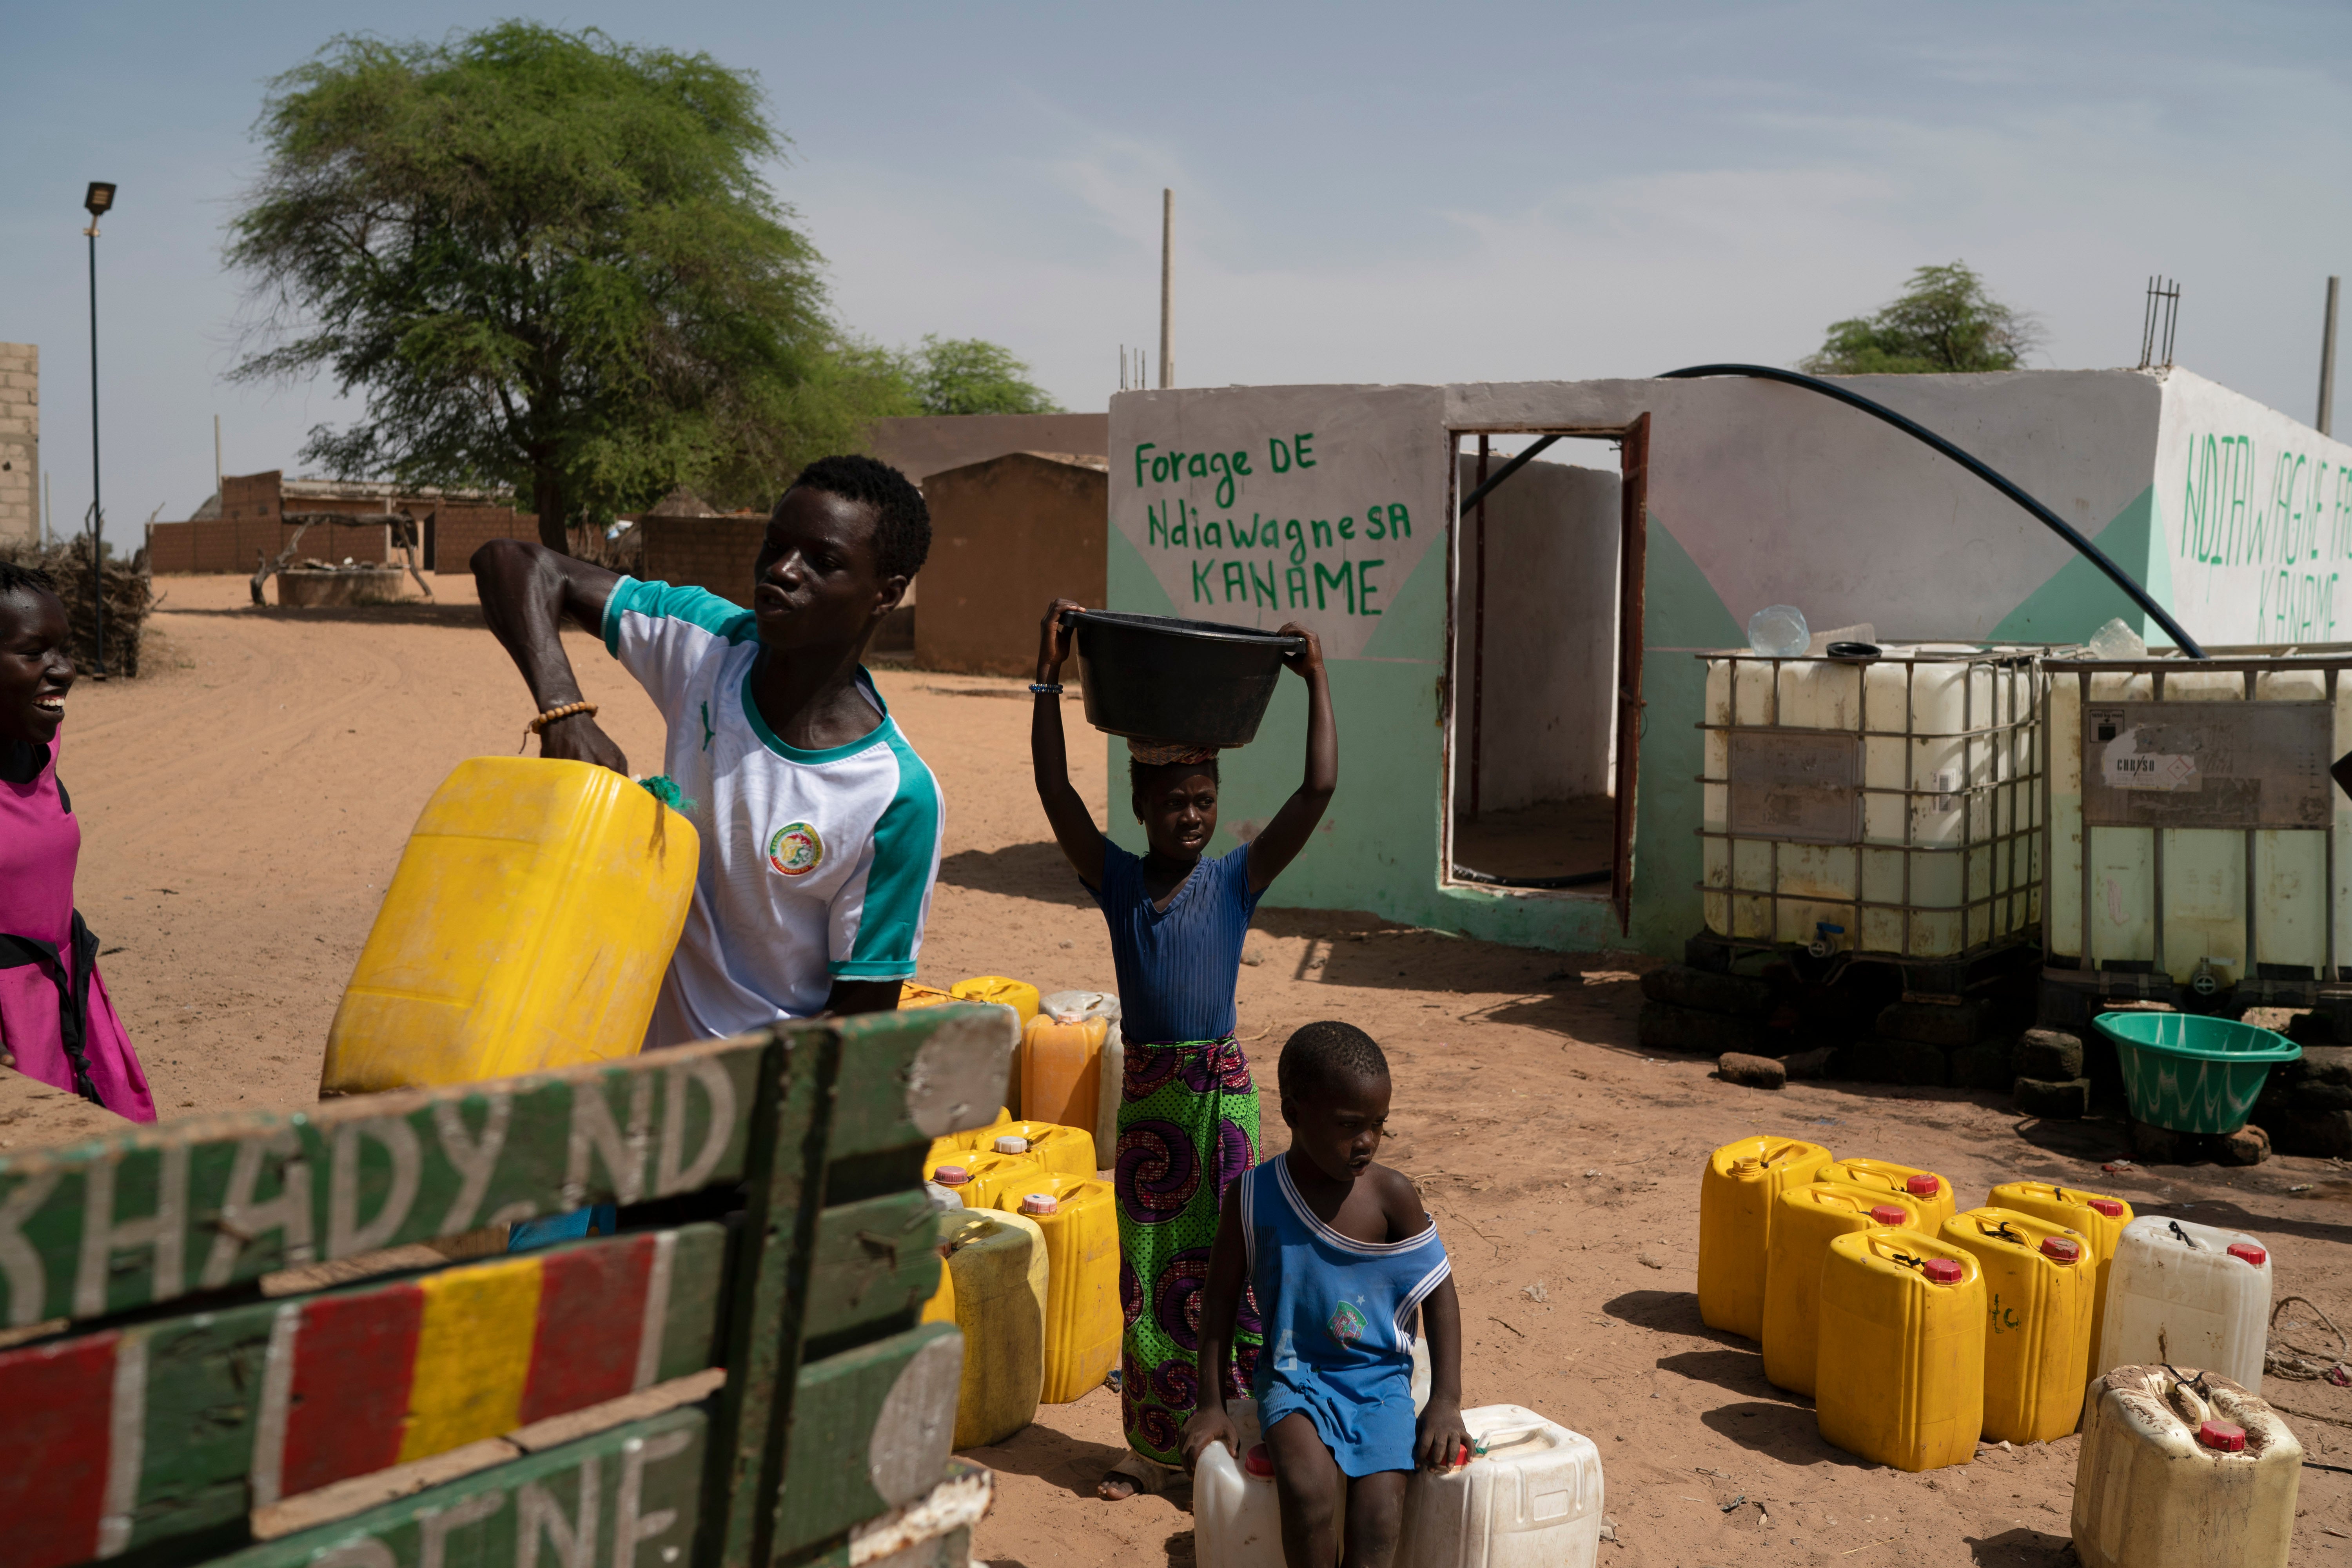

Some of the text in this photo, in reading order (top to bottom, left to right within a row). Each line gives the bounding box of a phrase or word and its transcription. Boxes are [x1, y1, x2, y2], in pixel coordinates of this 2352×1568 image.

[1135, 433, 1316, 508] Forage DE
[1192, 559, 1385, 615] KANAME
